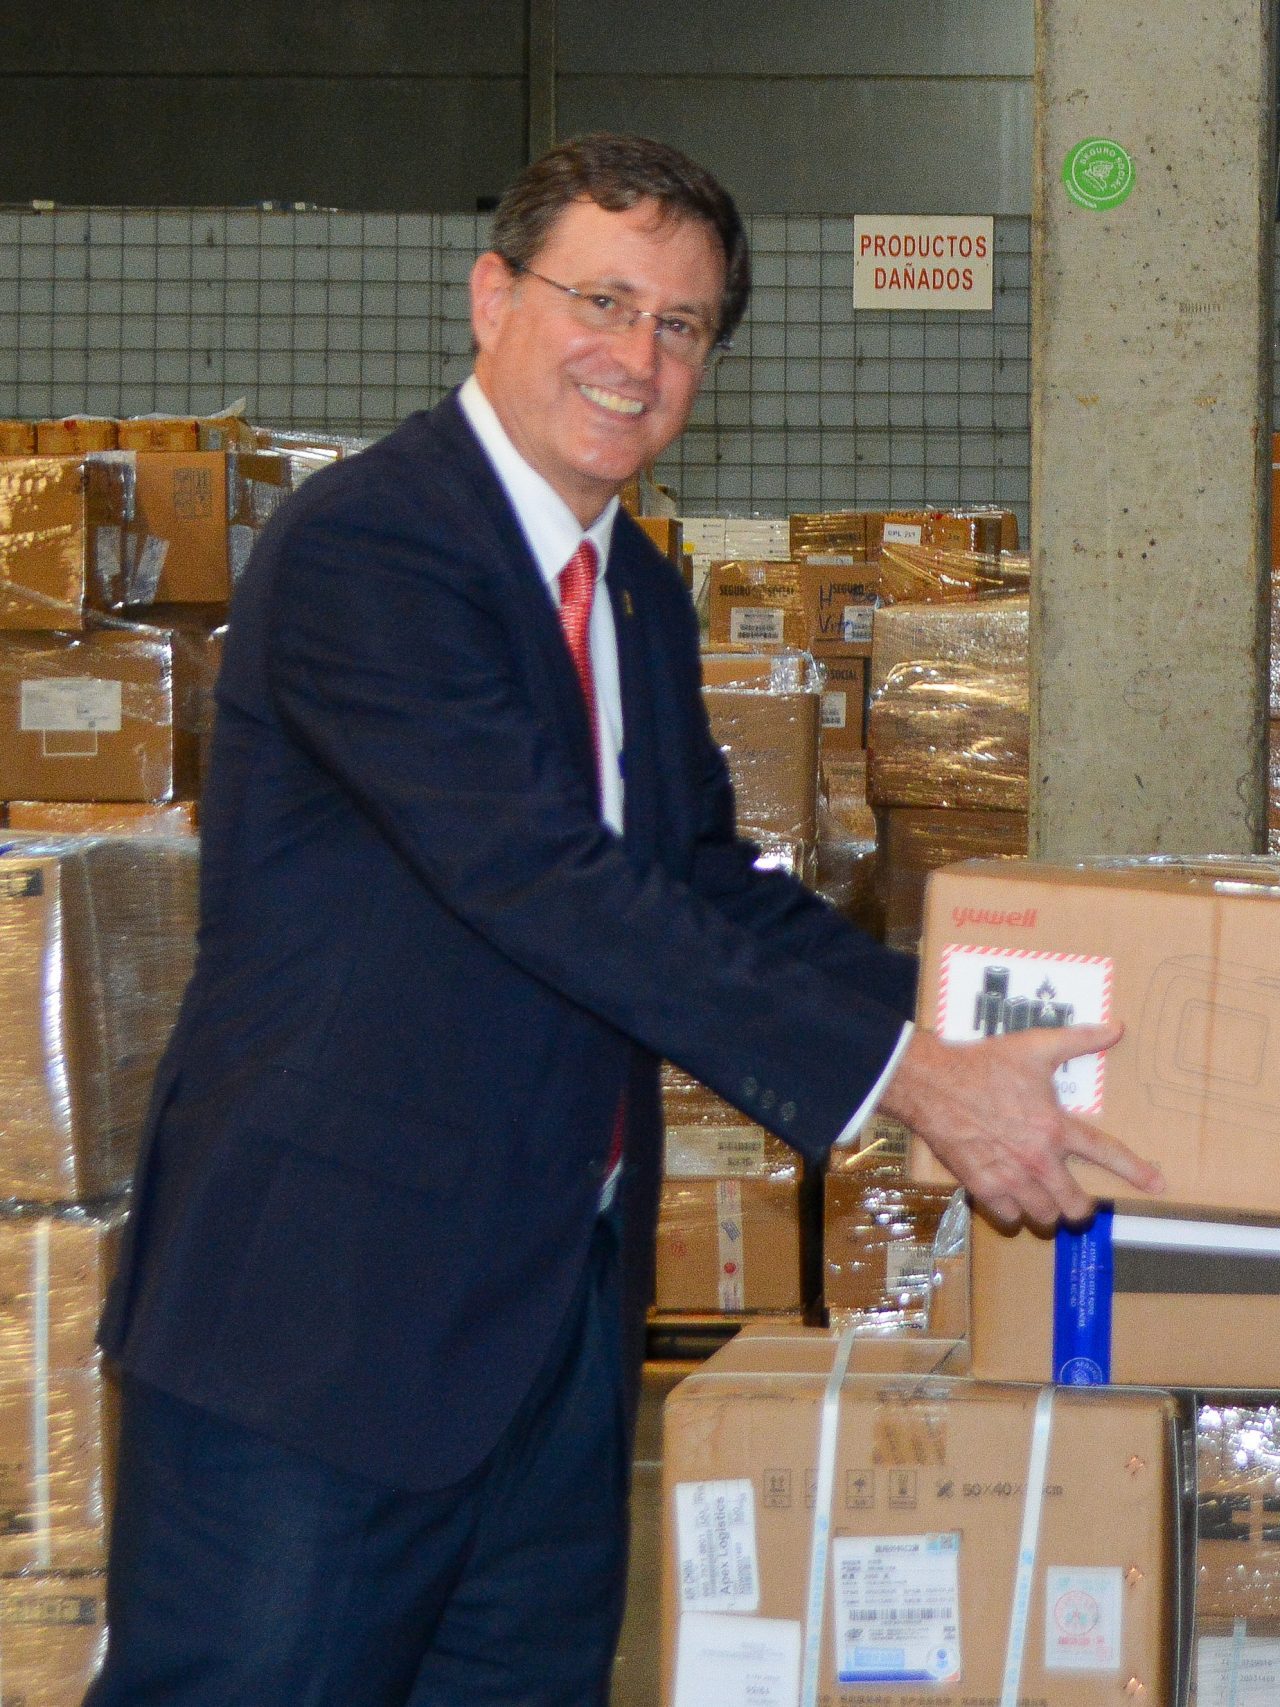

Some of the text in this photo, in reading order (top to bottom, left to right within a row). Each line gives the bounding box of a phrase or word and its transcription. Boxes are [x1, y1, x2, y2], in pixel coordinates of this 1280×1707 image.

[1080, 147, 1116, 164] SEGURO
[860, 234, 987, 258] PRODUCTOS
[874, 261, 973, 291] DAÑADOS
[719, 584, 751, 596] SEGURO
[952, 906, 1038, 928] yuwell
[715, 1495, 734, 1595] Apex Logistics
